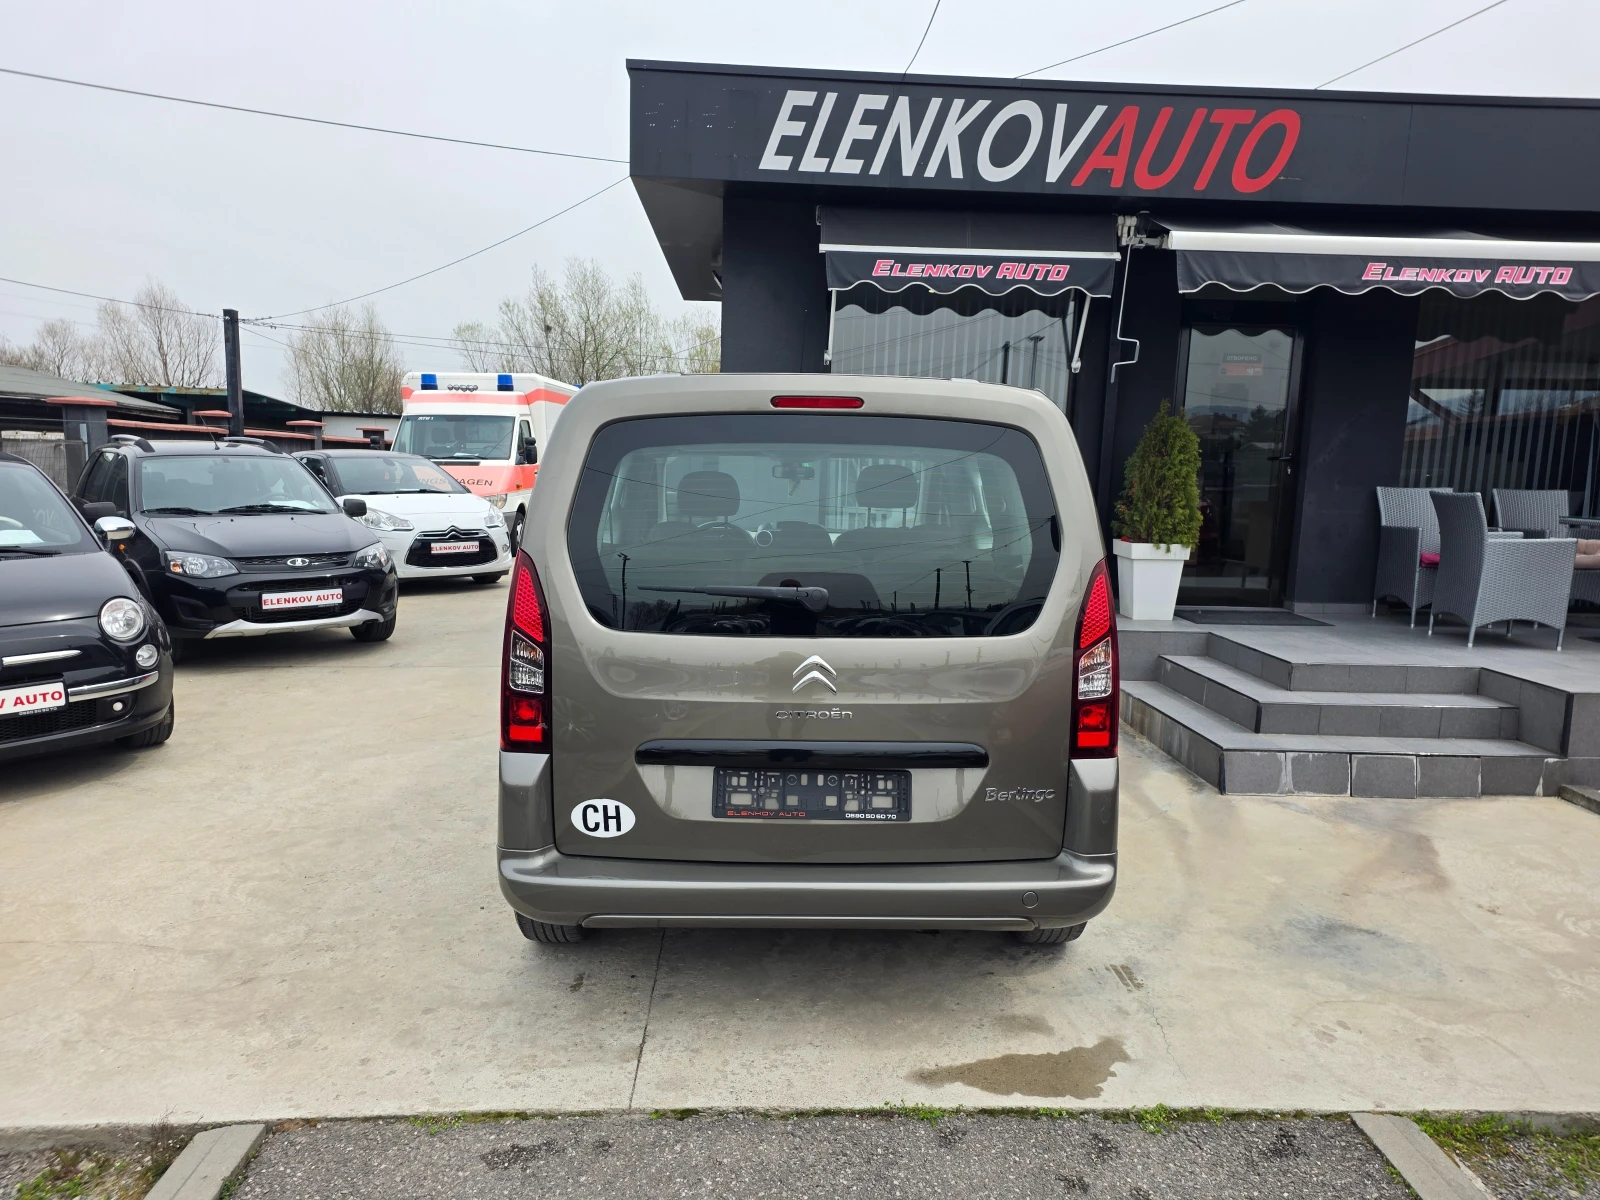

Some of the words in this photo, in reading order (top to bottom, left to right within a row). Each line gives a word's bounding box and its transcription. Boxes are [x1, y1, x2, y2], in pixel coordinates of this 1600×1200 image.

[996, 262, 1070, 281] AUTO
[1494, 266, 1573, 284] AUTO
[263, 595, 313, 606] ELENKOV
[316, 593, 343, 602] AUTO
[13, 690, 63, 707] AUTO
[985, 786, 1056, 803] Berlingo
[582, 803, 622, 832] CH
